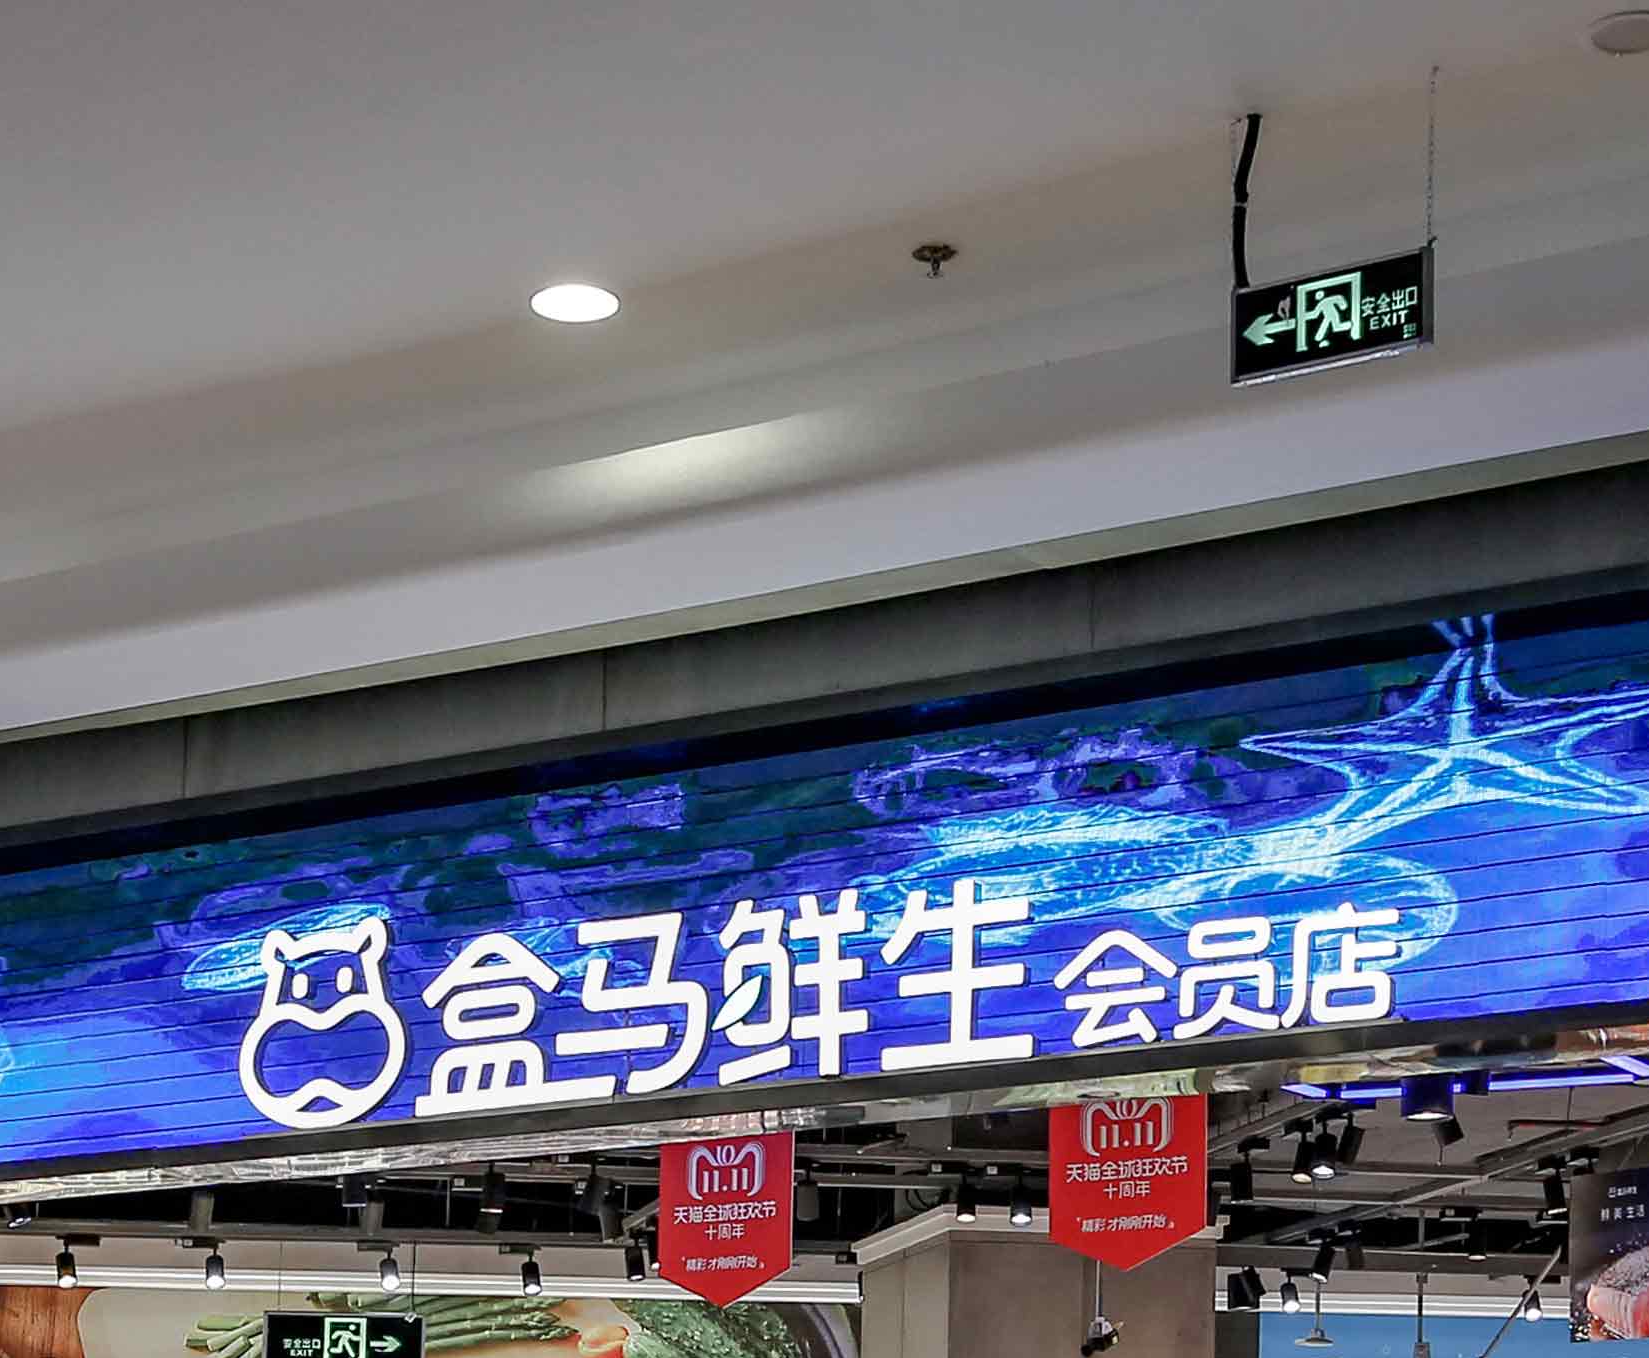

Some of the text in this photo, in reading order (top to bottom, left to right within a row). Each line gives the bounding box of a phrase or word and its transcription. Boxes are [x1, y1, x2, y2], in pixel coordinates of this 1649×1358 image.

[1362, 286, 1418, 317] 安全出口
[1369, 309, 1410, 330] EXIT
[414, 880, 1403, 1119] 盒马鲜生 会员店
[1100, 1121, 1154, 1149] 11.11
[703, 1168, 748, 1193] 11.11
[1066, 1156, 1188, 1183] 天猫全球狂欢节
[1103, 1181, 1151, 1200] 十周年
[673, 1201, 776, 1224] 天猫全球狂欢节
[705, 1224, 745, 1240] 十周年
[290, 1349, 314, 1357] EXIT
